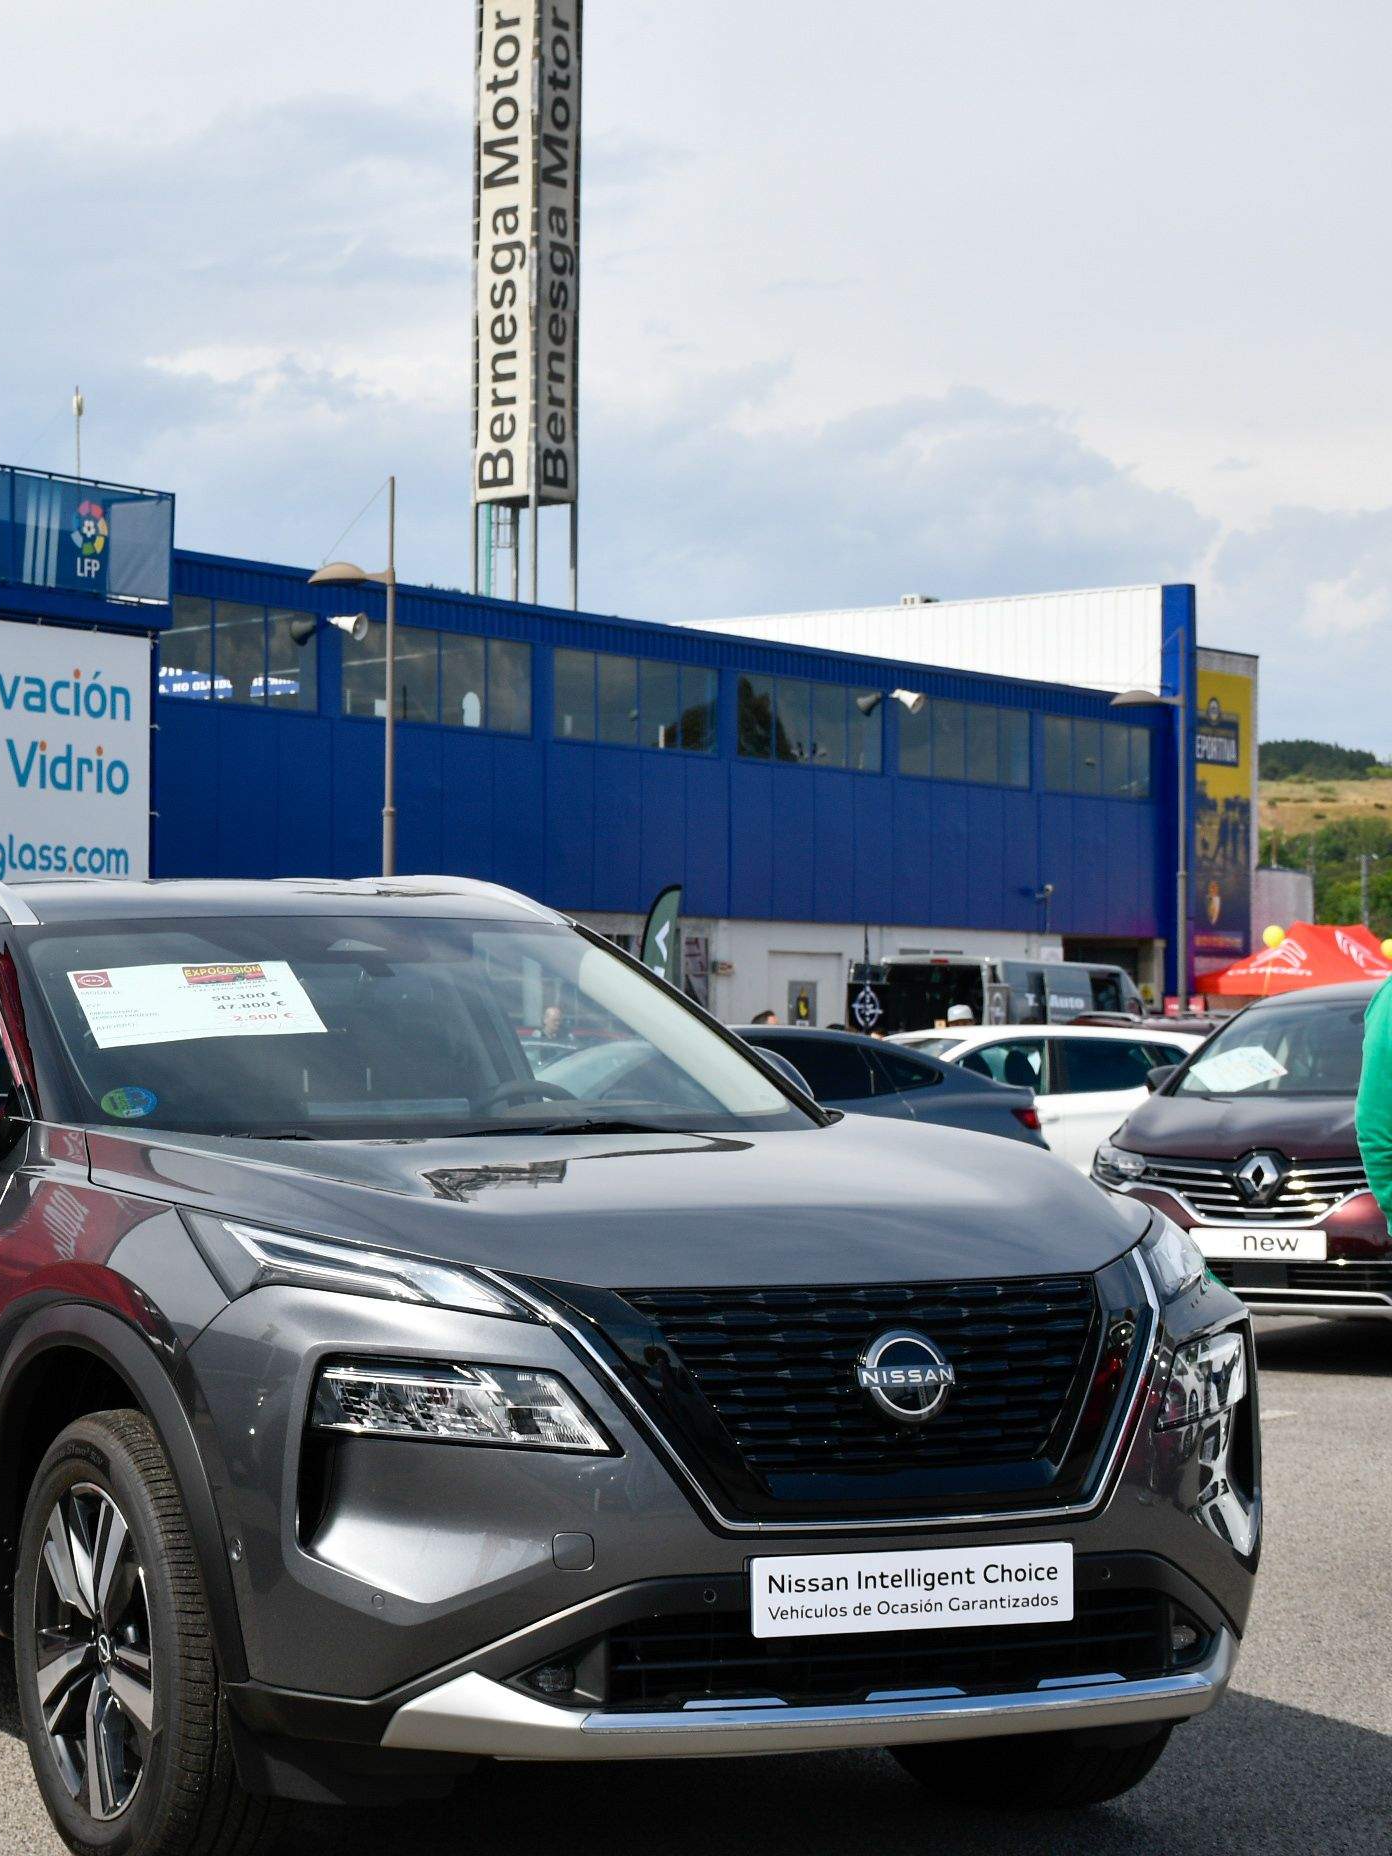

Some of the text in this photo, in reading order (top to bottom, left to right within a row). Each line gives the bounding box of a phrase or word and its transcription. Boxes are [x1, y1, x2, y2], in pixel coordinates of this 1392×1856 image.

[478, 9, 526, 490] Bernesga Motor
[542, 6, 575, 490] Bernesga Motor
[76, 556, 101, 579] LFP
[5, 738, 129, 796] Vidrio
[1243, 1235, 1299, 1252] new
[861, 1368, 954, 1385] NISSAN
[768, 1563, 1059, 1594] Nissan Intelligent Choice
[768, 1593, 1060, 1621] Vehículos de Ocasión Garantizados
